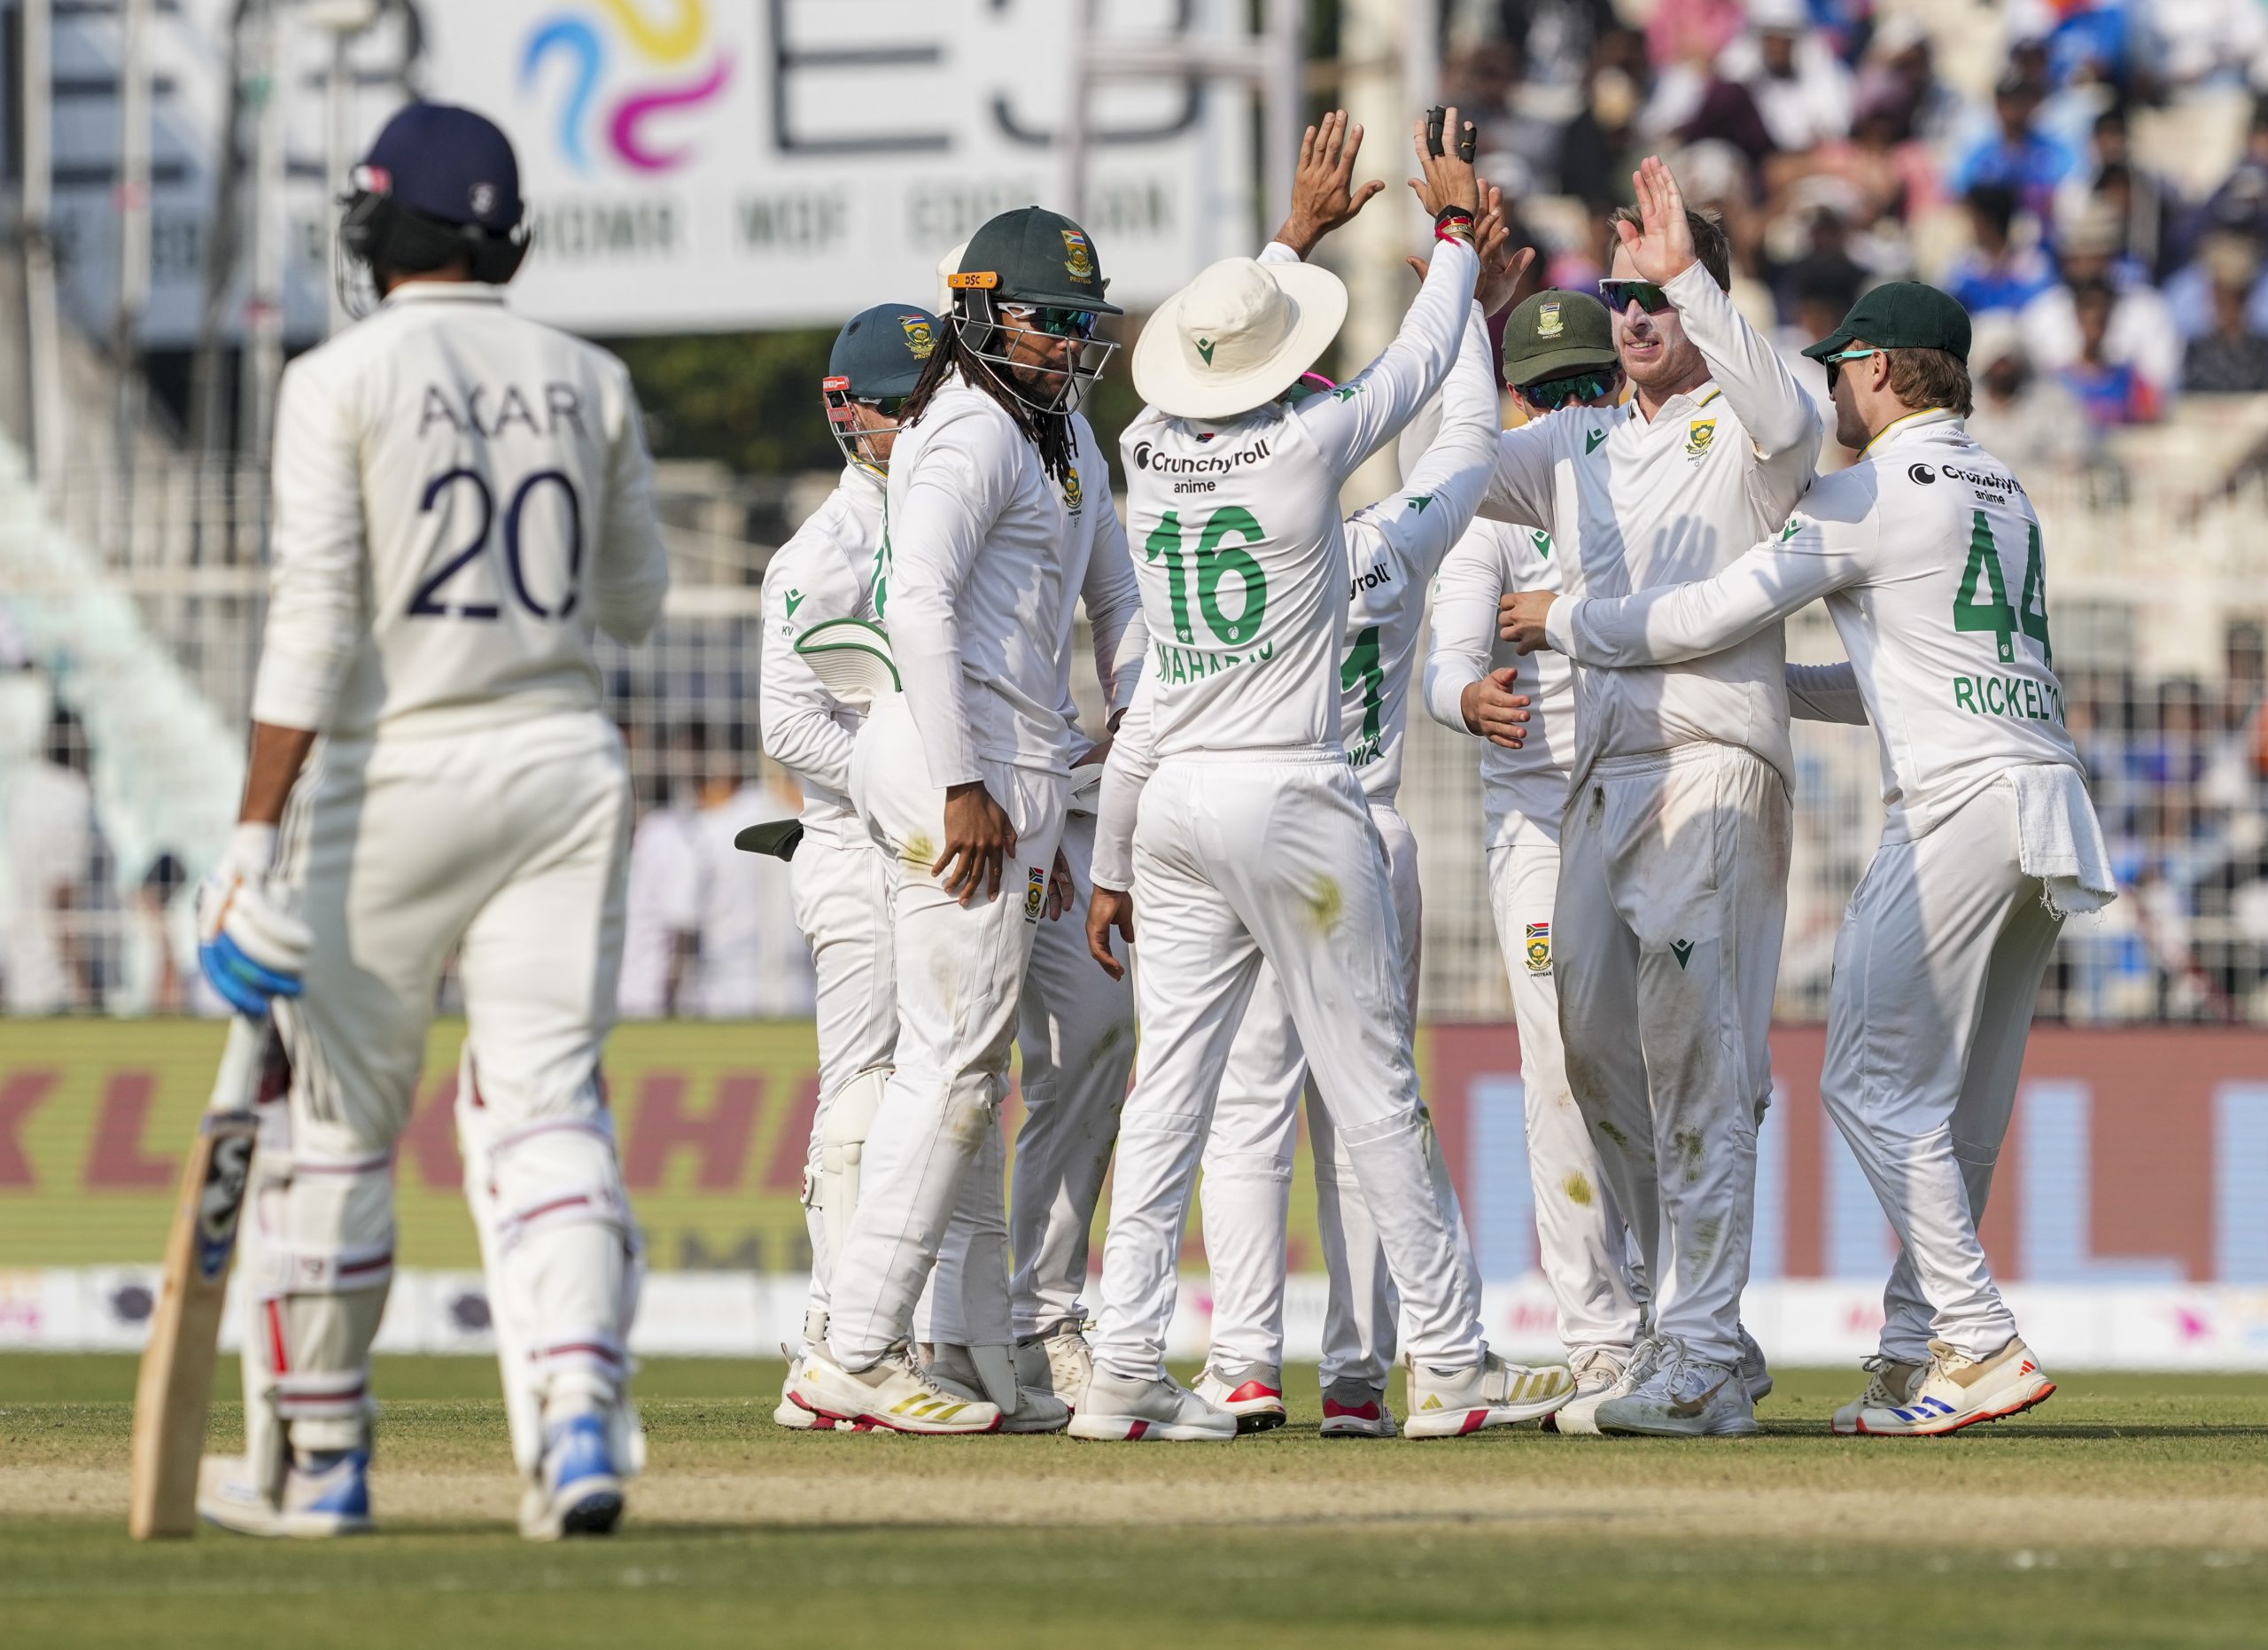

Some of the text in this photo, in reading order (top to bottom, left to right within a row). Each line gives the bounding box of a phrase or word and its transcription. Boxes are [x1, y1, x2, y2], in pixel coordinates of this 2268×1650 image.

[965, 275, 981, 285] DSC
[1152, 438, 1270, 474] Crunchyroll
[1174, 479, 1216, 494] anime
[1975, 489, 2005, 505] anime
[407, 467, 583, 619] 20
[1146, 506, 1268, 645] 16
[1953, 510, 2053, 673] 44
[781, 626, 794, 636] KV
